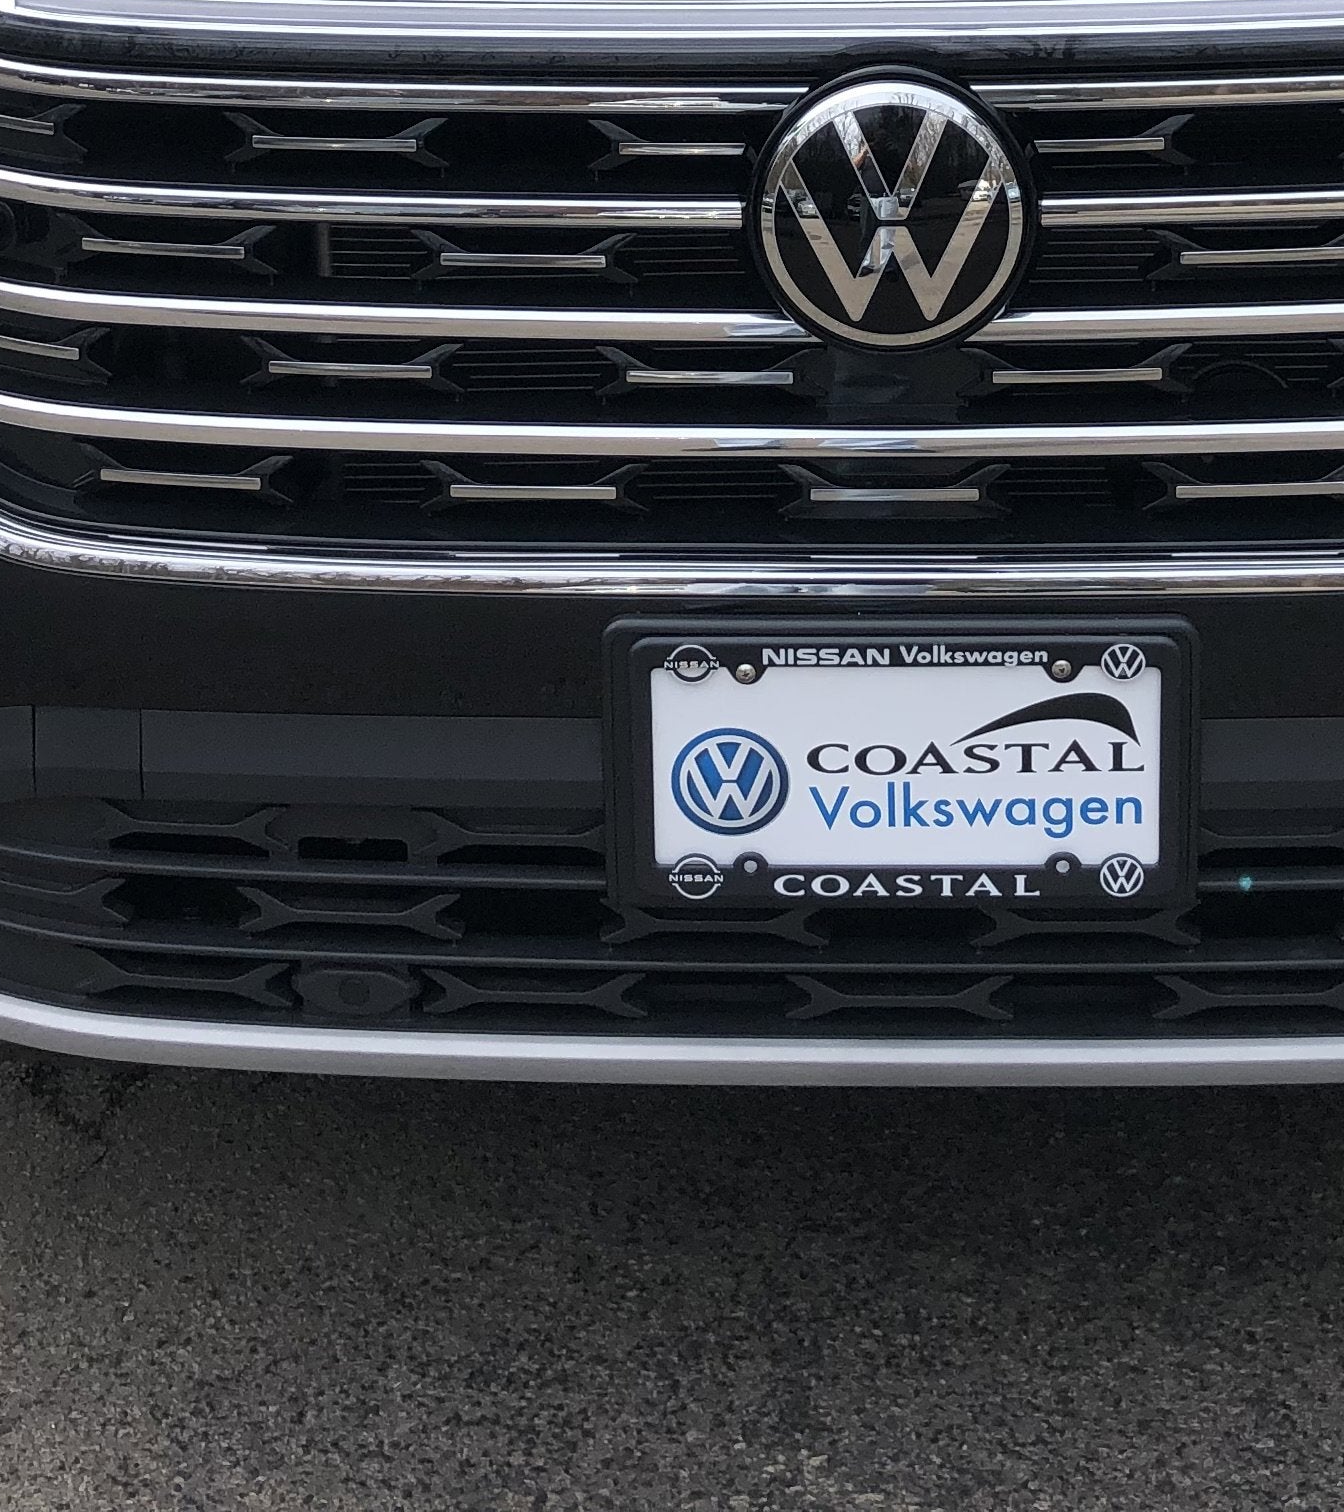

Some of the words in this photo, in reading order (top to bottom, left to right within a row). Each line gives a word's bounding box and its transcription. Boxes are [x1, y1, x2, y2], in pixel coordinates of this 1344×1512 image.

[777, 104, 1006, 322] VW
[663, 660, 720, 670] NISSAN
[762, 648, 891, 666] NISSAN
[899, 645, 1049, 667] Volkswagen
[1103, 645, 1144, 679] VW
[806, 739, 1145, 775] COASTAL
[678, 736, 780, 822] VW
[809, 781, 1143, 838] Volkswagen
[668, 873, 724, 883] NISSAN
[773, 872, 1041, 897] COASTAL
[1102, 859, 1142, 894] VW
